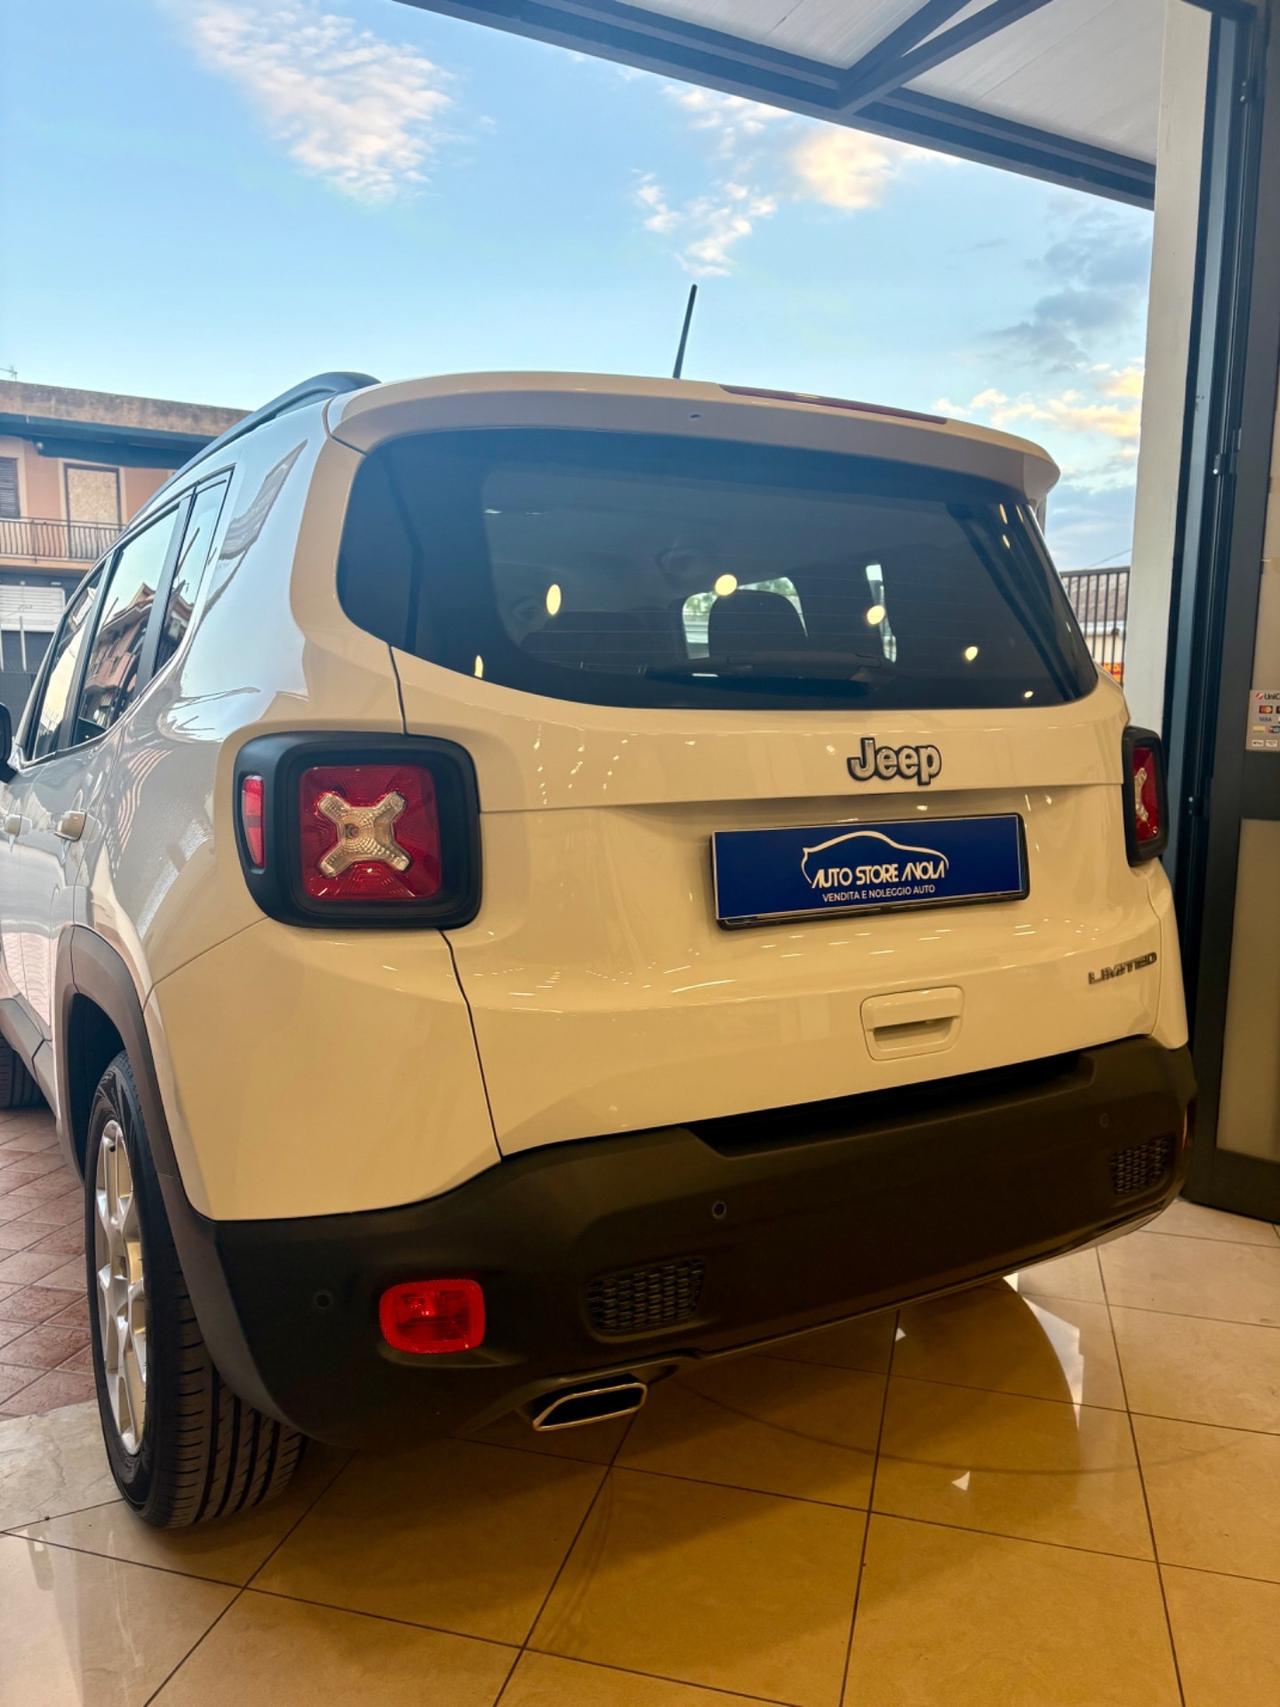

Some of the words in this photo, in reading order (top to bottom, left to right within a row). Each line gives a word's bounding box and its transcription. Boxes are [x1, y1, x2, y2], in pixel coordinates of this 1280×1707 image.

[847, 737, 942, 786] Jeep
[811, 868, 853, 888] AUTO
[856, 864, 899, 885] STORE
[822, 891, 860, 902] VENDITA
[861, 889, 868, 899] E
[868, 886, 912, 899] NOLEGGIO
[913, 884, 936, 895] AUTO
[1088, 952, 1157, 984] LIMITED
